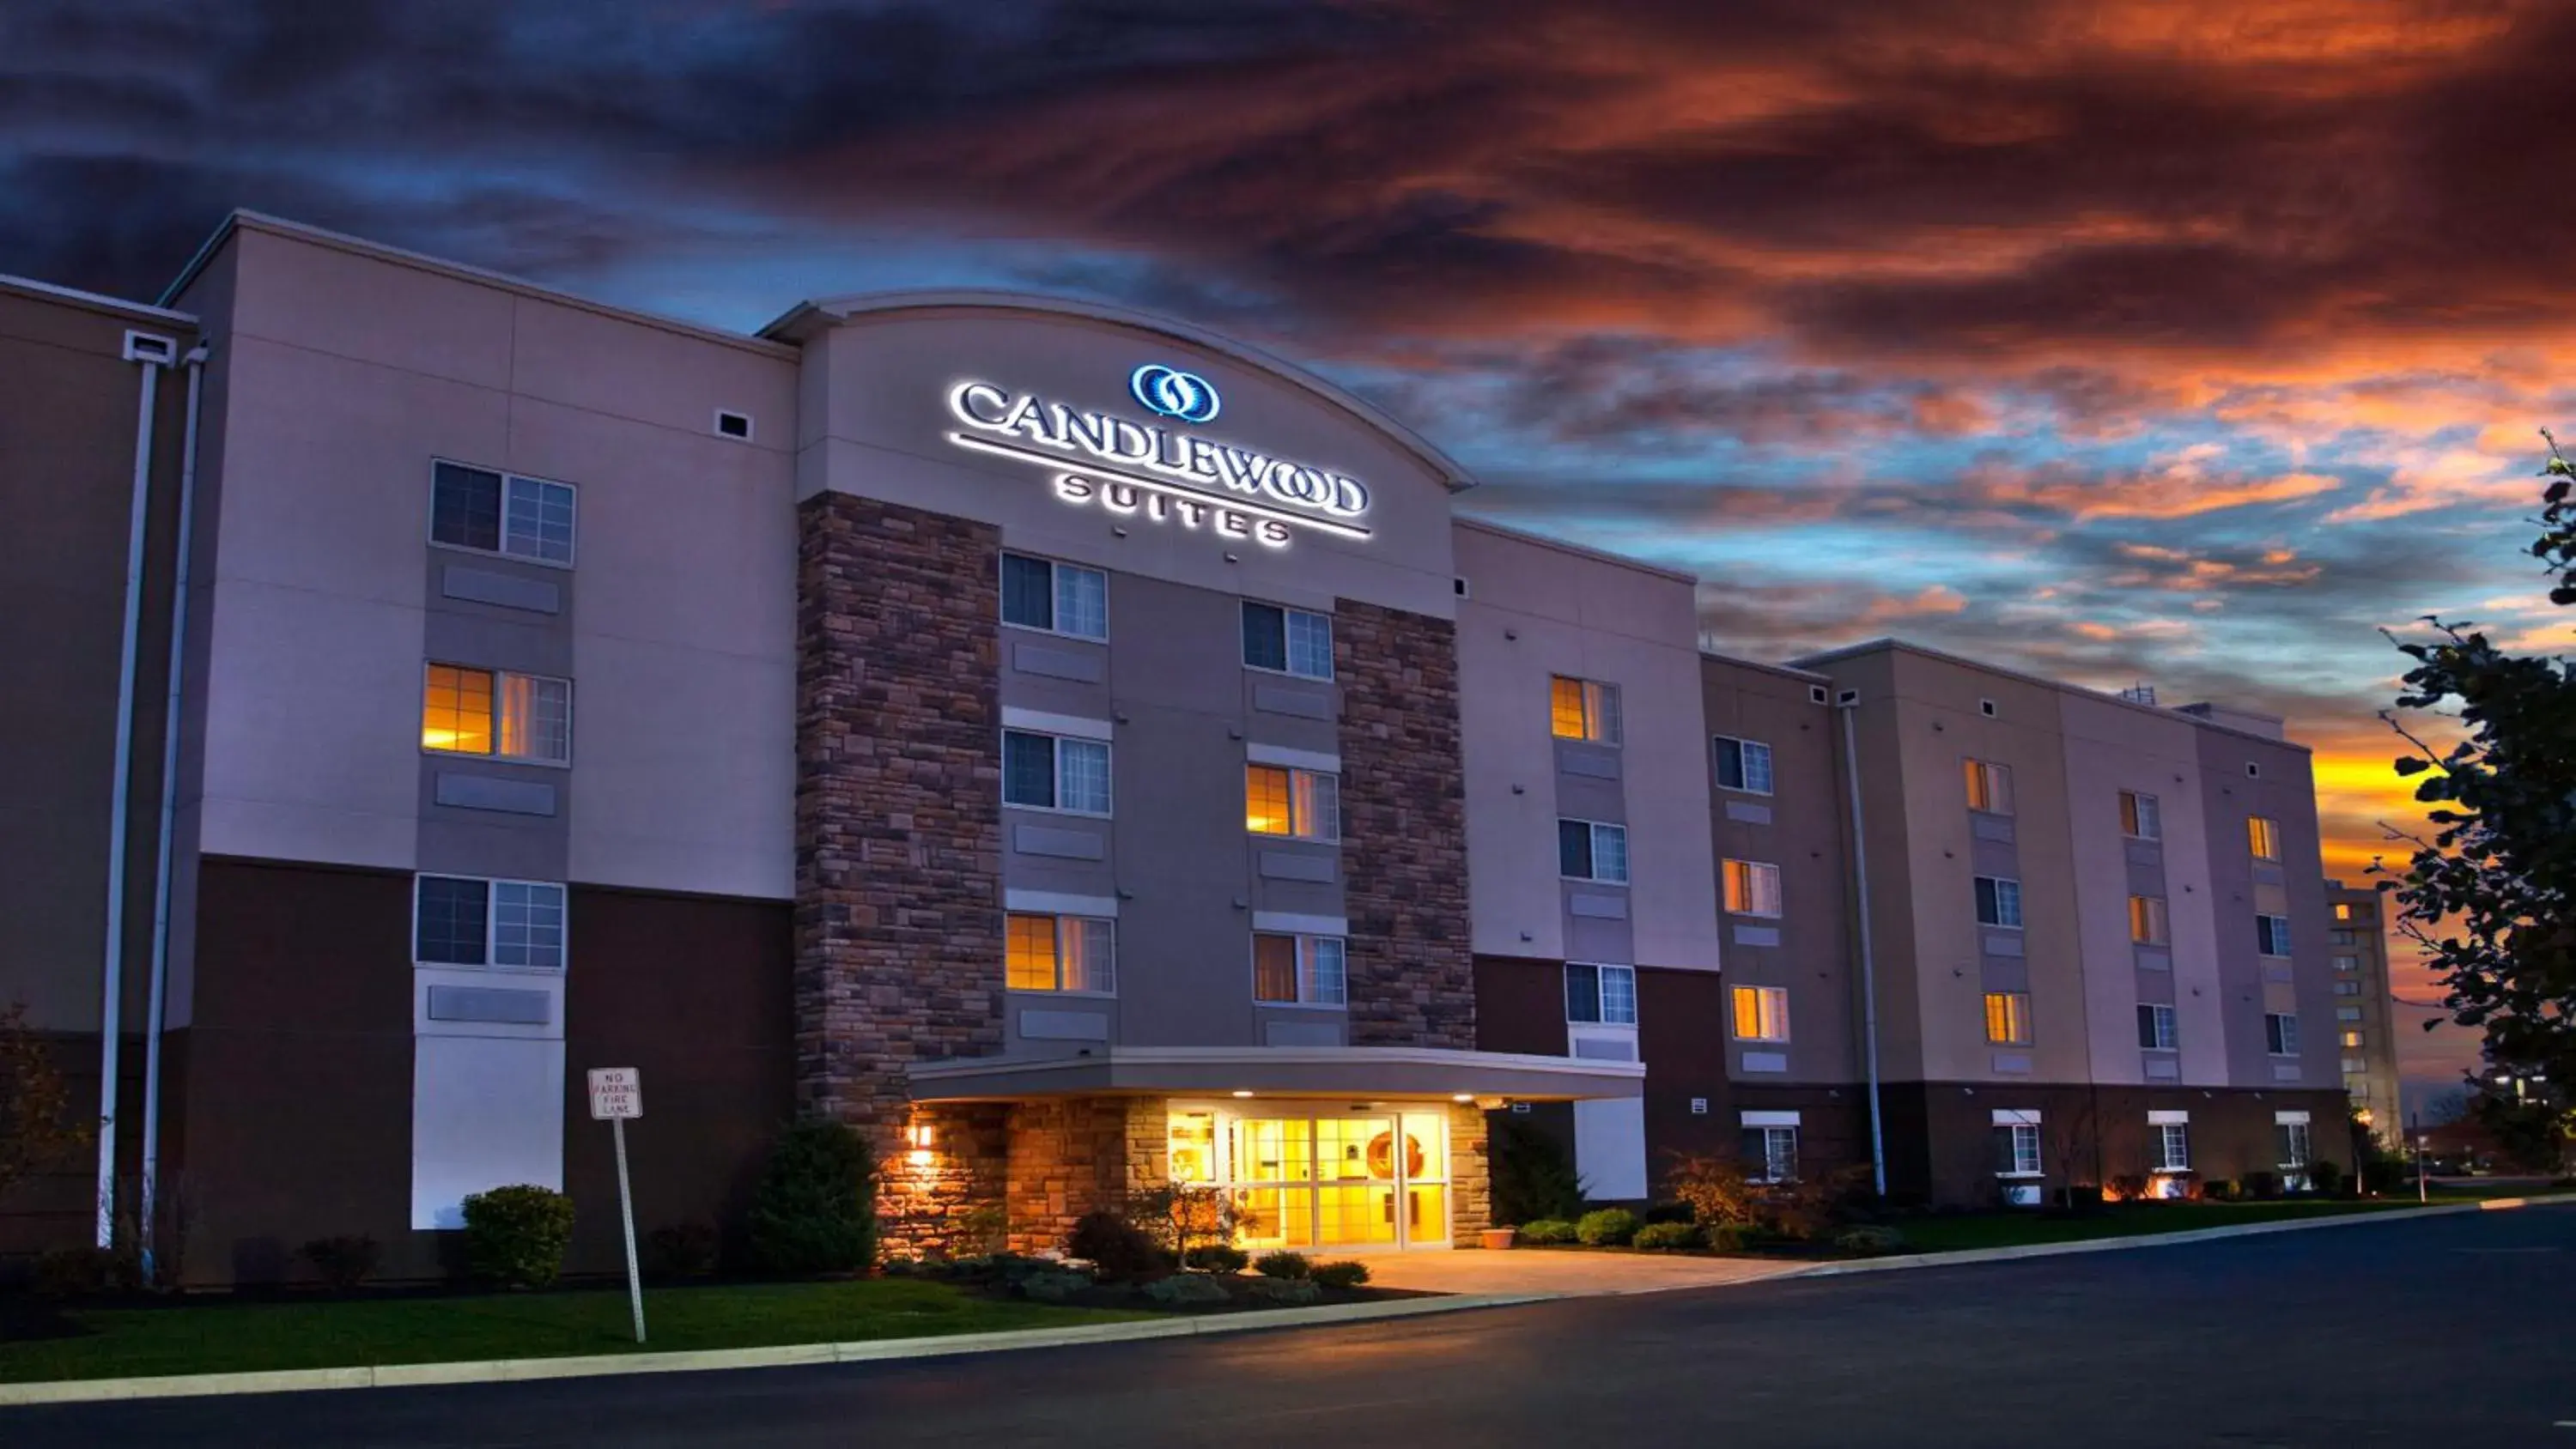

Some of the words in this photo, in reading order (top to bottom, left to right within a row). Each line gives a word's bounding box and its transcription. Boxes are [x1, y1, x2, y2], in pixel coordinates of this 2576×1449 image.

[950, 379, 1369, 517] CANDLEWOOD
[1056, 472, 1291, 548] SUITES
[605, 1072, 623, 1082] NO
[604, 1094, 627, 1104] FIRE
[604, 1105, 629, 1114] LANE
